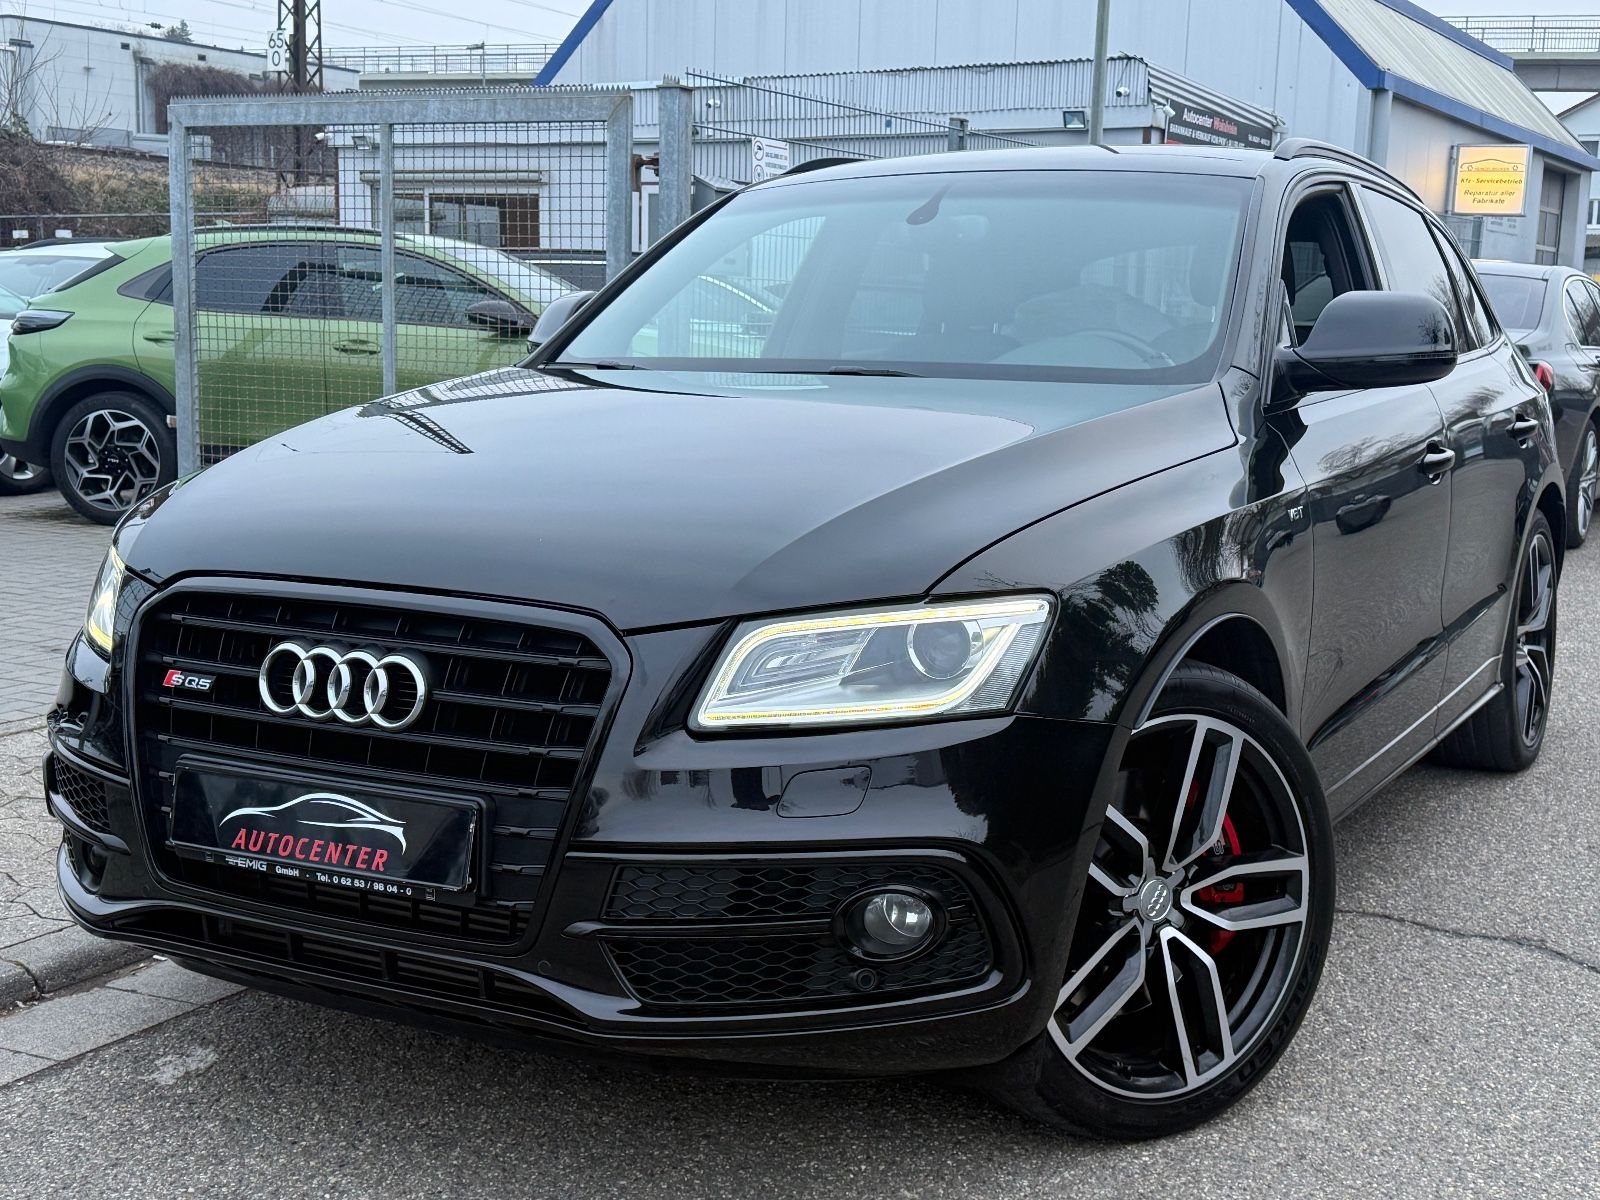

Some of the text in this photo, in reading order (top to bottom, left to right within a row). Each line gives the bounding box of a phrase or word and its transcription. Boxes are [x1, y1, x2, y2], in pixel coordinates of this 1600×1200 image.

[268, 32, 284, 49] 65
[272, 50, 281, 67] 0
[1183, 108, 1213, 128] Autocenter
[1464, 189, 1499, 197] Reparatur
[1472, 197, 1506, 205] Fabrikate
[170, 673, 212, 690] SQ5
[231, 827, 389, 872] AUTOCENTER
[275, 865, 300, 877] GmbH
[315, 872, 331, 883] Tel.
[332, 875, 339, 884] 0
[340, 876, 352, 887] 62
[354, 879, 365, 888] 53
[373, 881, 385, 891] 98
[386, 884, 398, 894] 04
[405, 887, 412, 895] 0
